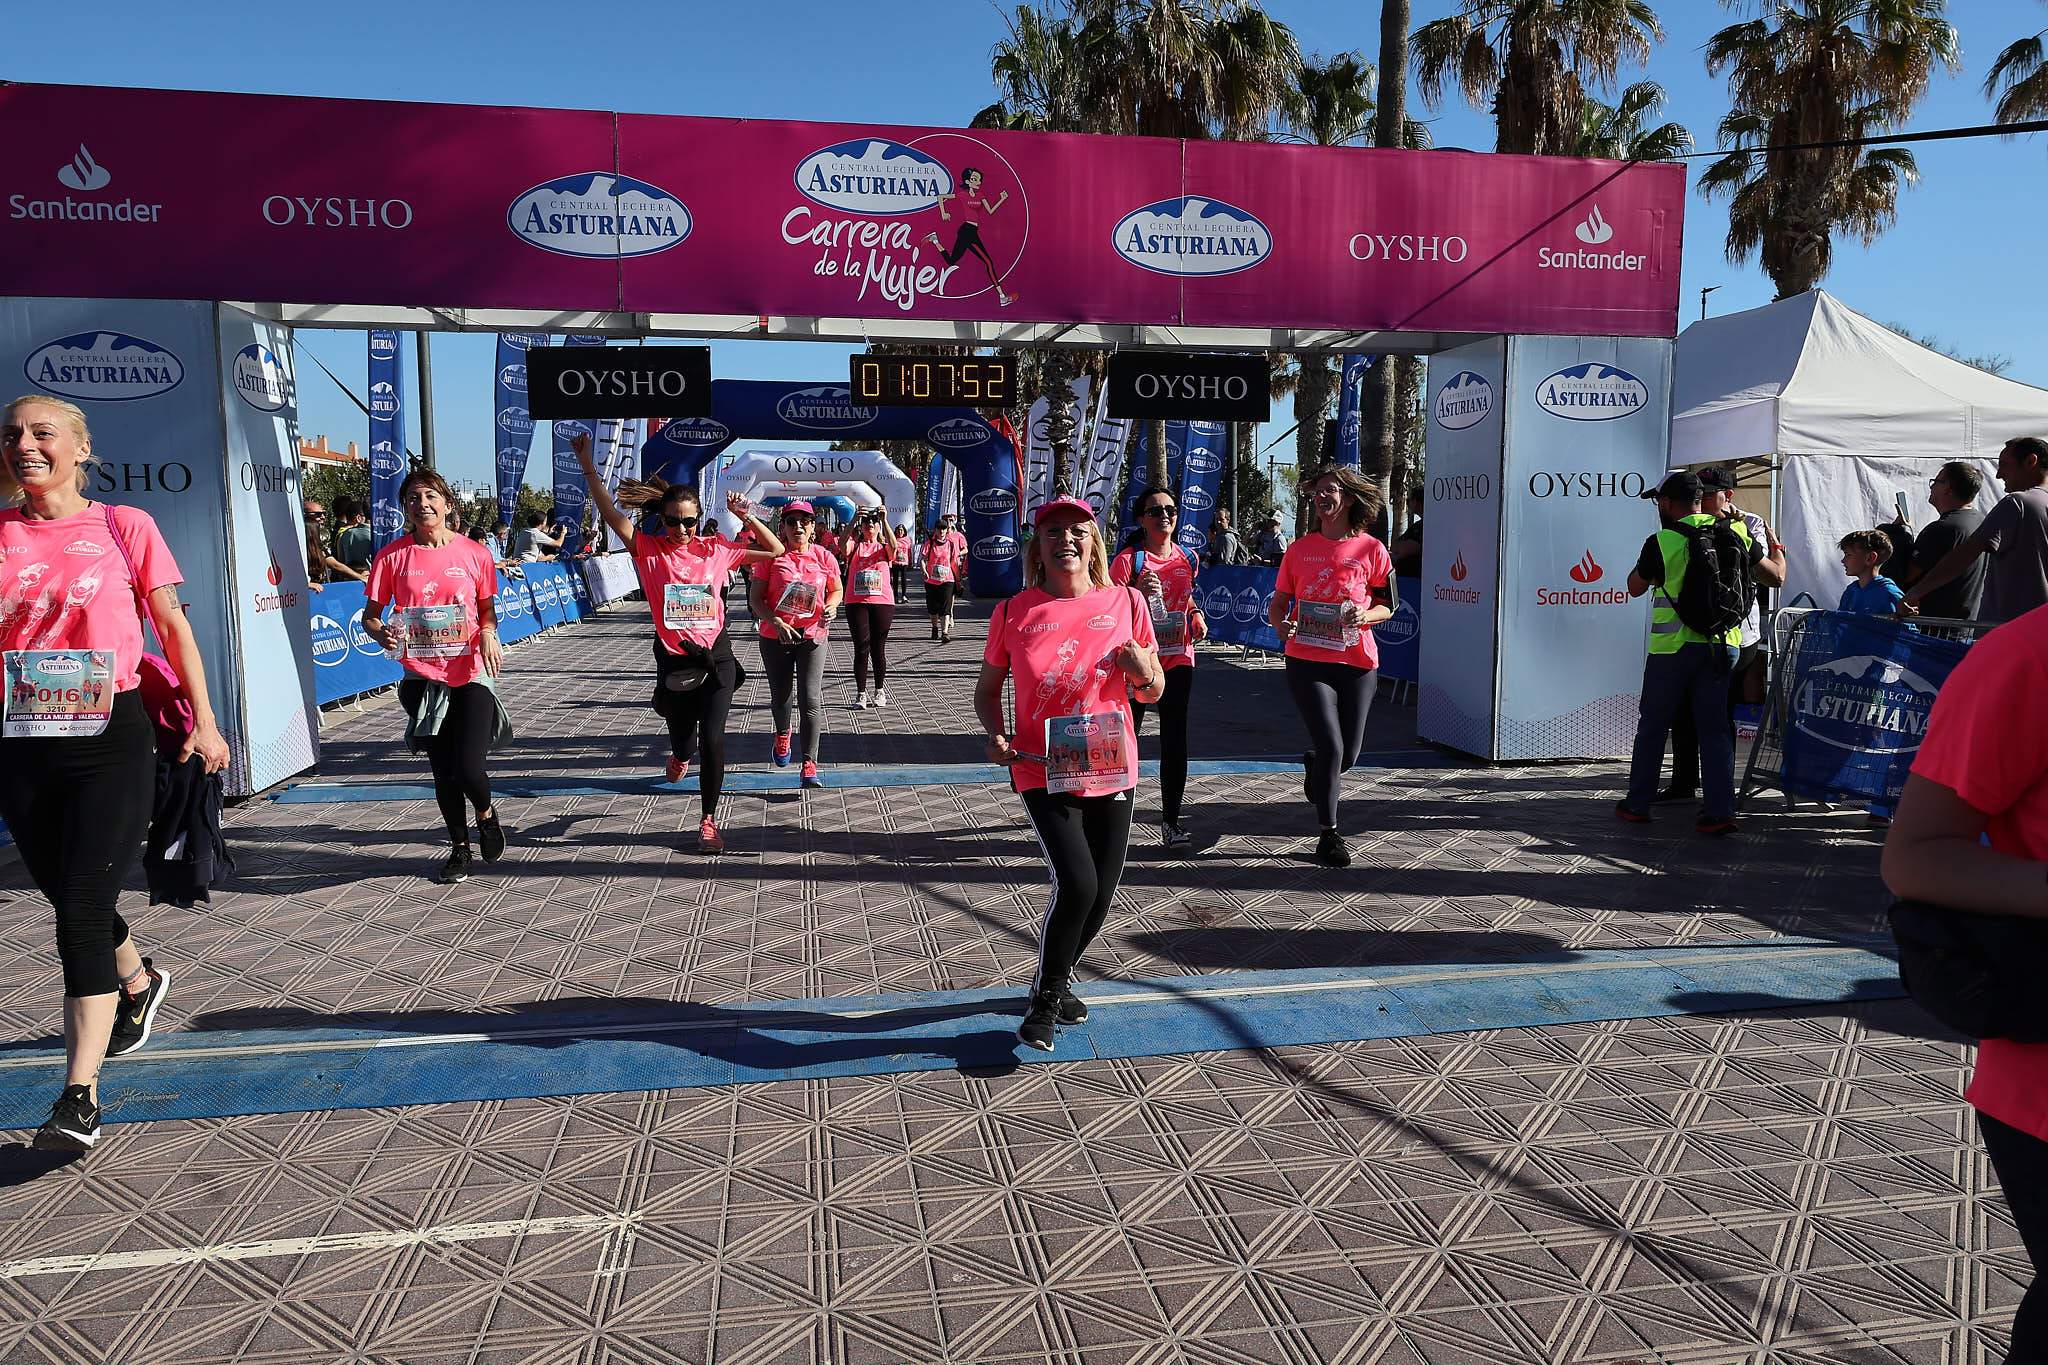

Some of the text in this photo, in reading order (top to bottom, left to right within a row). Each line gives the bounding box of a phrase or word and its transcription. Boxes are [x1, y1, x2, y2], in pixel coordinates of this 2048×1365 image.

[807, 163, 940, 197] ASTURIANA
[832, 162, 937, 176] CENTRAL LECHERA
[10, 194, 162, 224] Santander
[262, 195, 413, 230] OYSHO
[551, 200, 608, 210] CENTRAL
[523, 201, 680, 237] ASTURIANA
[781, 206, 912, 249] Carrera
[1150, 222, 1256, 234] CENTRAL LECHERA
[1129, 223, 1261, 257] ASTURIANA
[1349, 233, 1468, 264] OYSHO
[1538, 246, 1646, 272] Santander
[814, 246, 960, 311] de la Mujer
[37, 355, 174, 385] ASTURIANA
[60, 354, 167, 364] CENTRAL LECHERA
[558, 369, 686, 396] OYSHO
[1134, 373, 1248, 401] OYSHO
[1561, 382, 1637, 391] CENTRAL LECHERA
[1439, 396, 1489, 419] ASTURIANA
[1543, 383, 1640, 408] ASTURIANA
[785, 399, 871, 420] ASTURIANA
[668, 428, 725, 441] ASTURIANA
[932, 429, 987, 441] ASTURIANA
[774, 456, 854, 474] OYSHO
[240, 462, 295, 494] OYSHO
[1432, 472, 1490, 503] OYSHO
[1528, 471, 1646, 499] OYSHO
[254, 592, 298, 614] Santander
[1433, 583, 1481, 606] Santander
[1536, 585, 1630, 607] Santander
[1024, 622, 1060, 634] OYSHO
[40, 660, 81, 671] ASTURIANA
[46, 705, 67, 713] 3210
